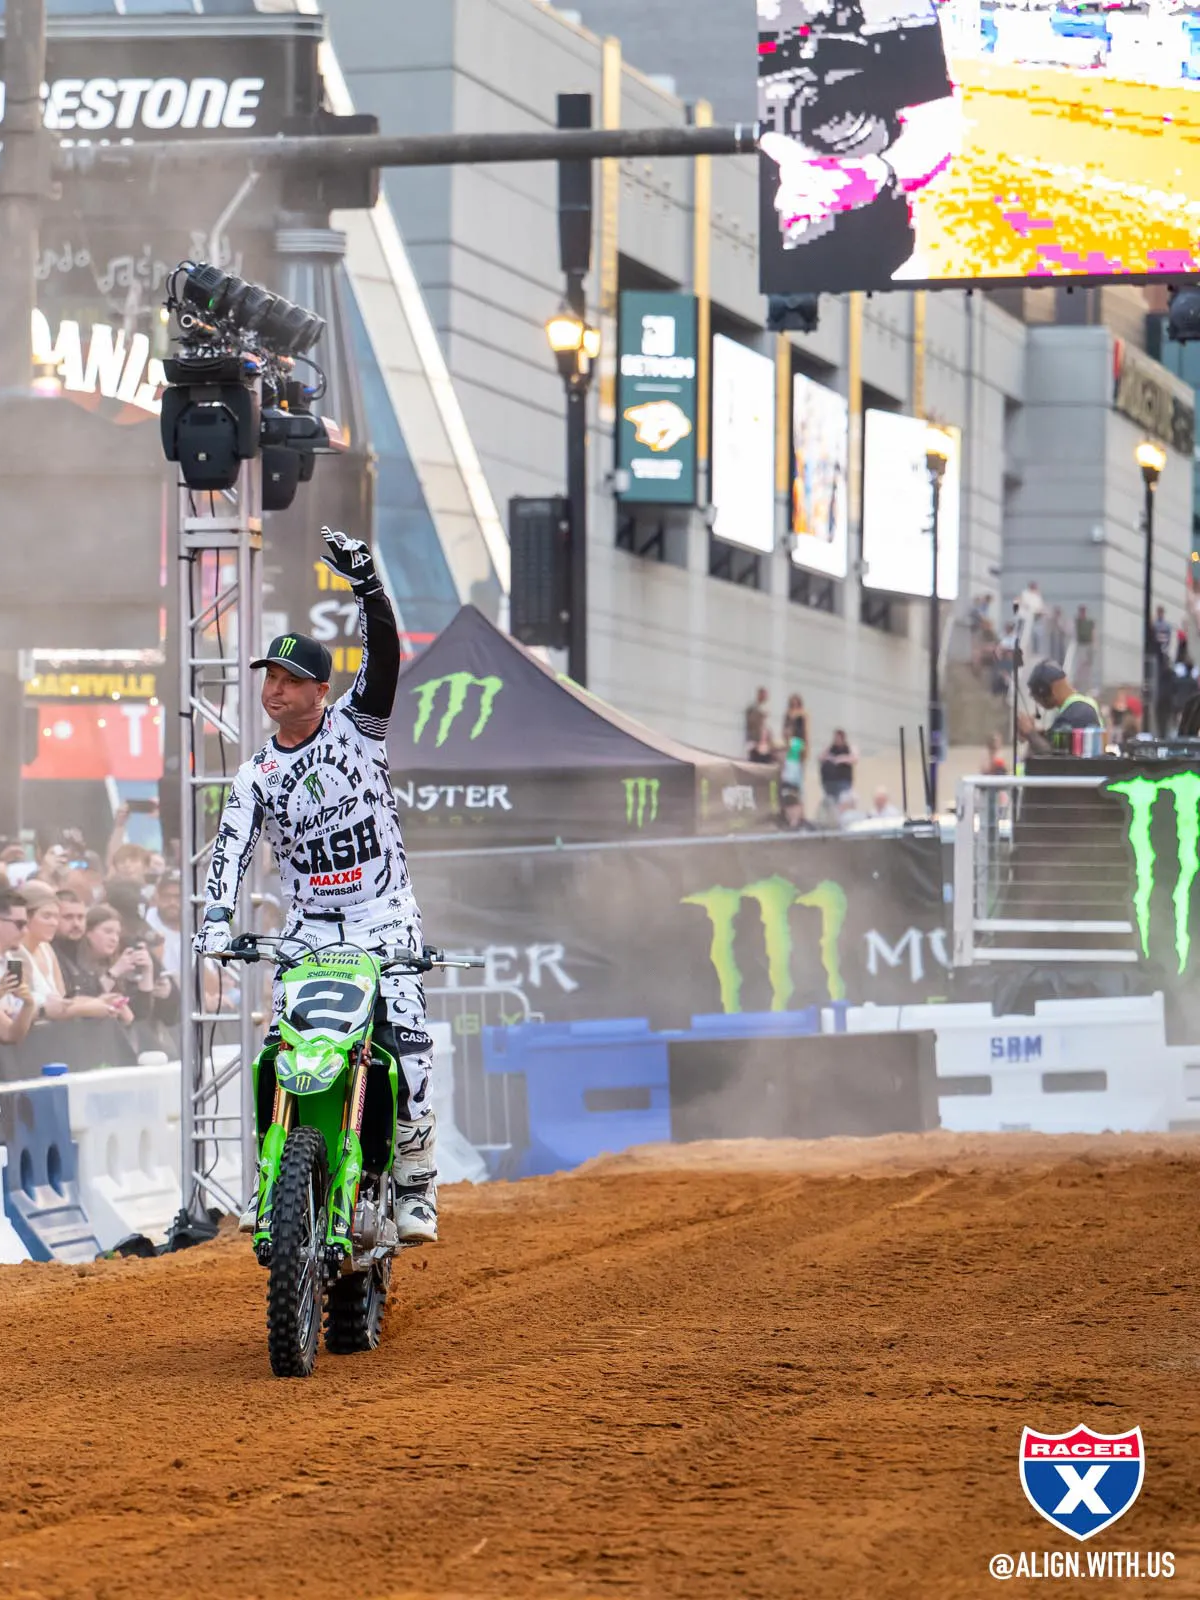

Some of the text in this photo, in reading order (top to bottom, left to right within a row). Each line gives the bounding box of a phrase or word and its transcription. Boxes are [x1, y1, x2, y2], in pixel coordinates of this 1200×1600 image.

[275, 744, 363, 829] NASHVILLE
[289, 814, 382, 876] CASH
[309, 867, 363, 887] MAXXIS
[312, 883, 363, 898] Kawasaki
[306, 970, 354, 980] SHOWTIME
[289, 980, 366, 1034] 2
[400, 1031, 432, 1044] CASH
